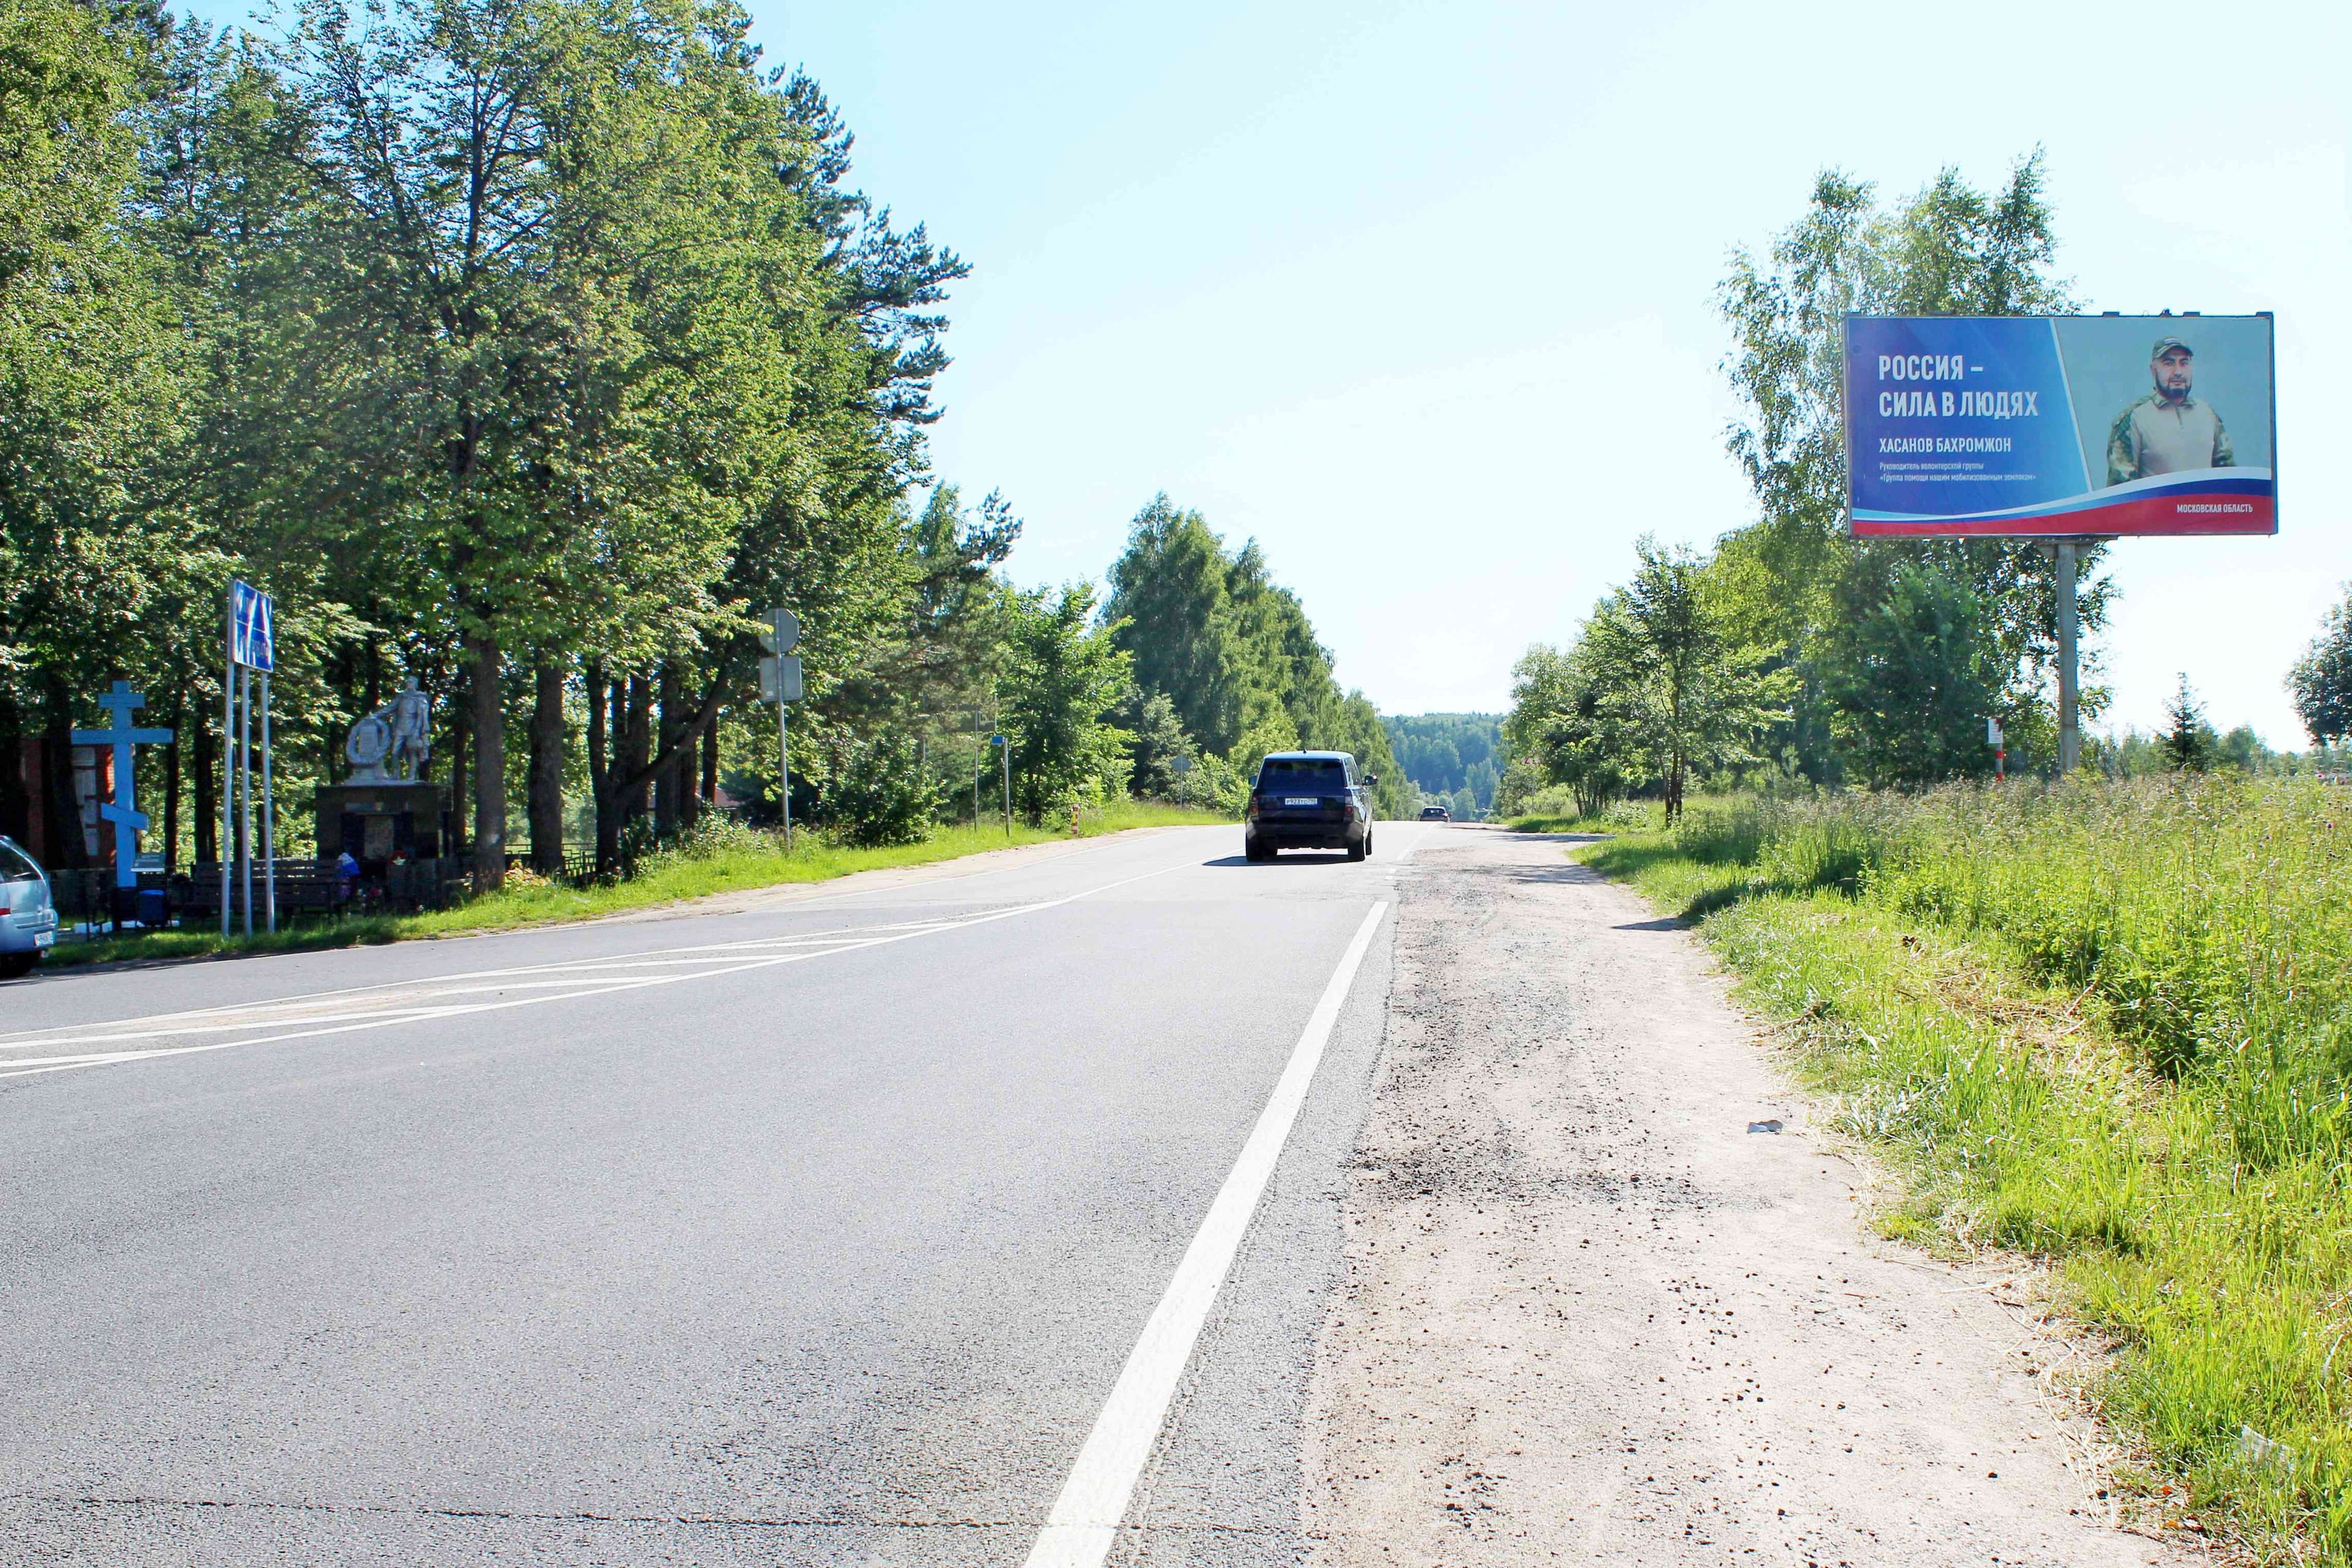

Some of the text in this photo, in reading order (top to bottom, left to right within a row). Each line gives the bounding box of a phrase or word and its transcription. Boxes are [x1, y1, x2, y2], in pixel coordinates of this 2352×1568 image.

[1879, 355, 1964, 380] РОССИЯ
[1879, 391, 2038, 420] СИЛА В ЛЮДЯХ
[1879, 437, 2011, 453] ХАСАНОВ БАХРОМЖОН
[1879, 462, 1920, 471] Руководитель
[2177, 504, 2253, 513] МОСКОВСКАЯ ОБЛАСТЬ
